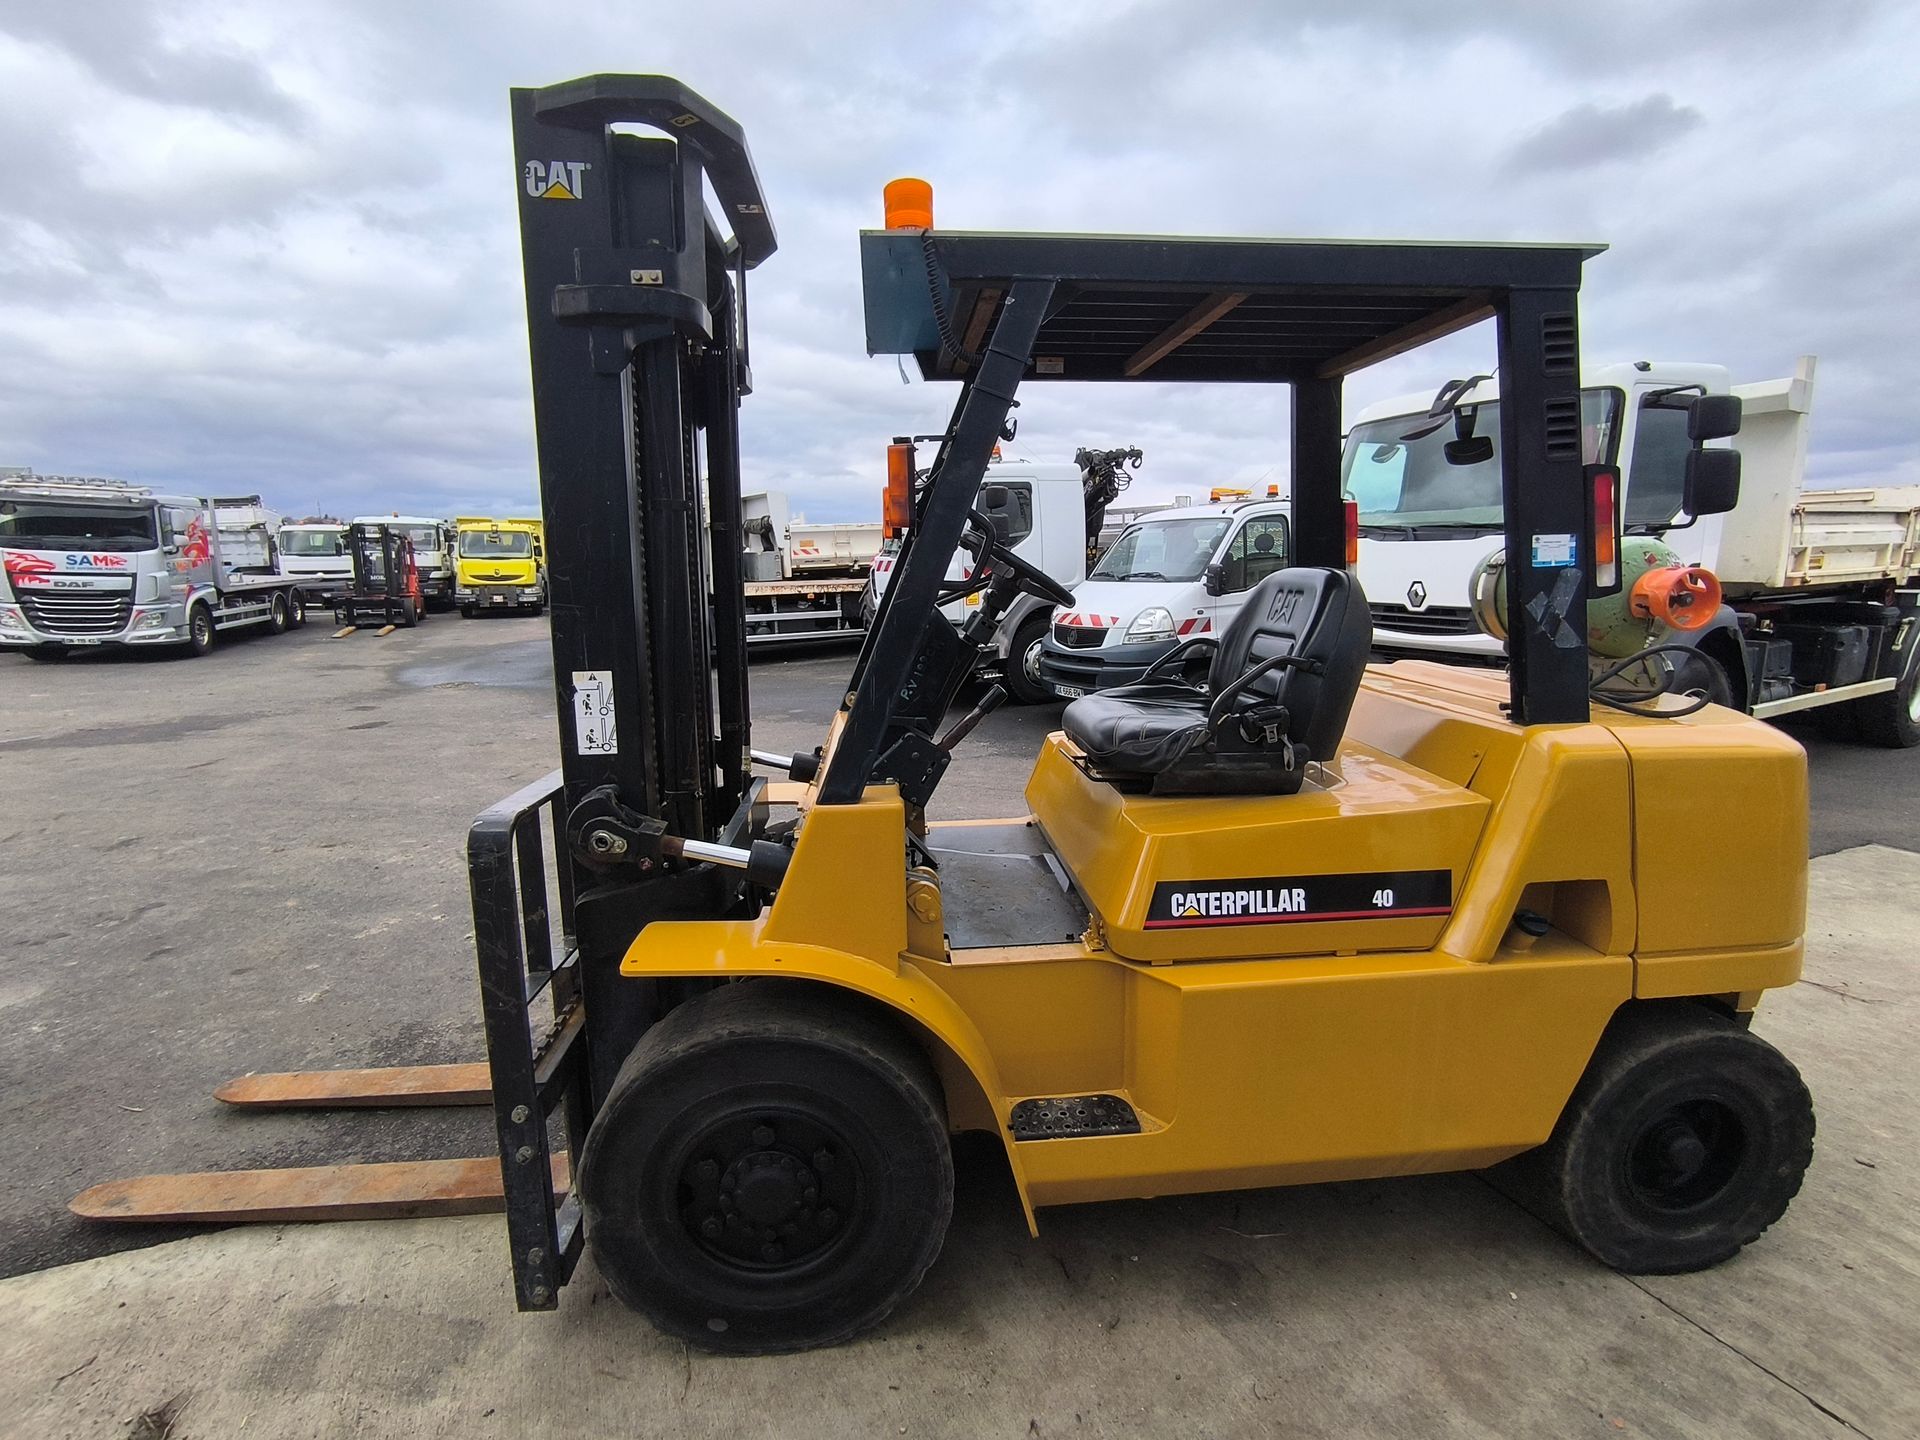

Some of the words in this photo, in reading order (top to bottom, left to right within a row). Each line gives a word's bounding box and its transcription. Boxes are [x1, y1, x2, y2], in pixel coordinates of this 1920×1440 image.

[526, 160, 585, 200] CAT
[1266, 588, 1305, 625] CAT
[1171, 888, 1306, 917] CATERPILLAR
[1372, 889, 1394, 908] 40
